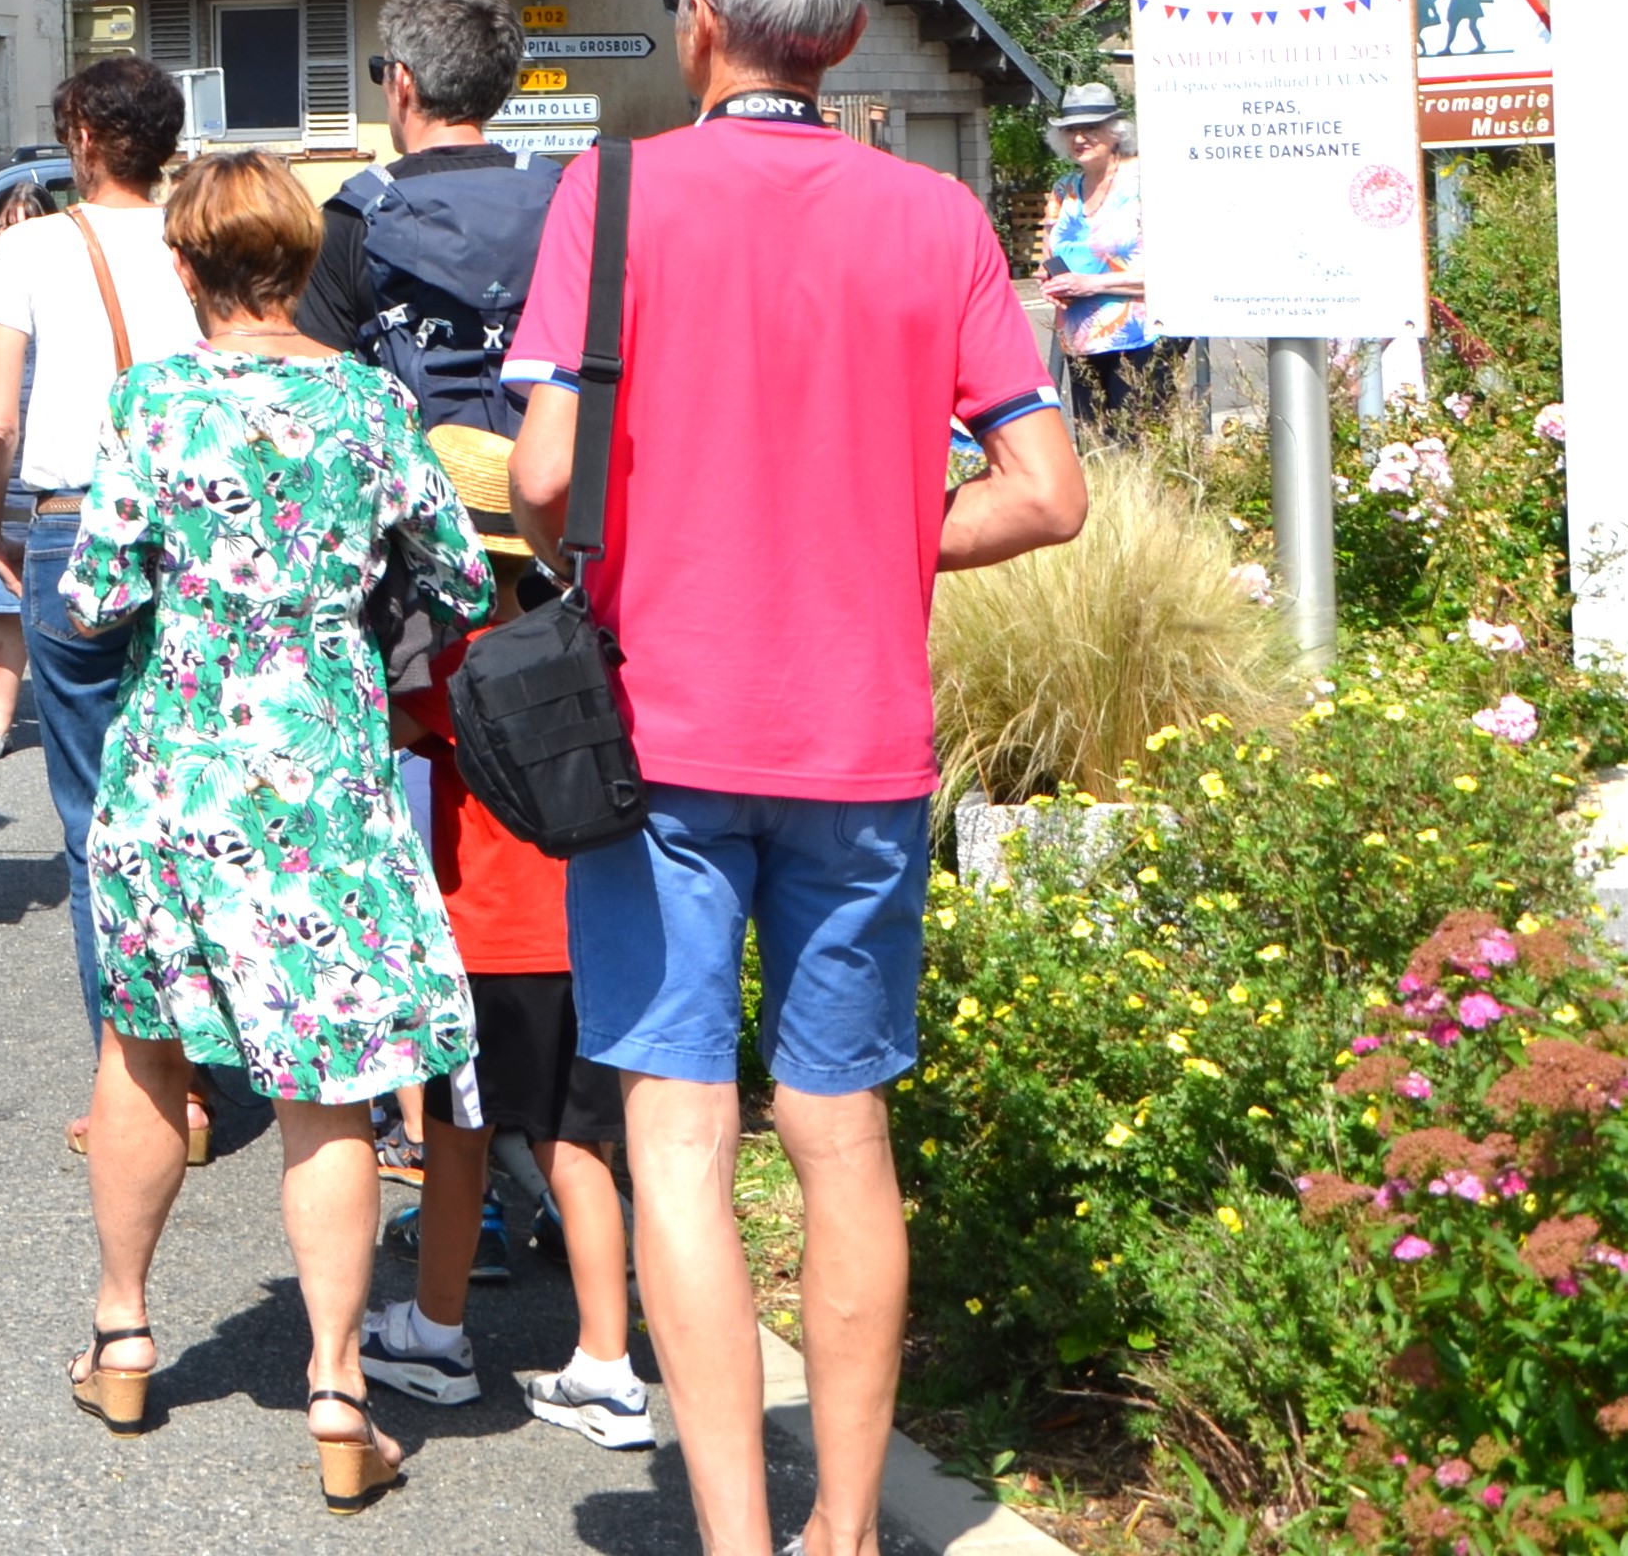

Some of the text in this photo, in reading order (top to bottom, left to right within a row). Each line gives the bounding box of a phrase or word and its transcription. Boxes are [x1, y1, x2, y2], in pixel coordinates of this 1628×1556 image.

[523, 11, 563, 23] D 102
[525, 41, 642, 53] PITAL DU GROSBOIS
[1349, 44, 1391, 61] 2023
[520, 73, 561, 84] D 112
[497, 102, 592, 116] AMIROLLE
[726, 97, 805, 116] SONY
[1242, 100, 1301, 115] REPAS,
[1204, 120, 1343, 138] FEUX D'ARTIFICE
[488, 135, 593, 148] agerie-Musée
[1188, 147, 1199, 160] &
[1270, 142, 1362, 159] DANSANTE
